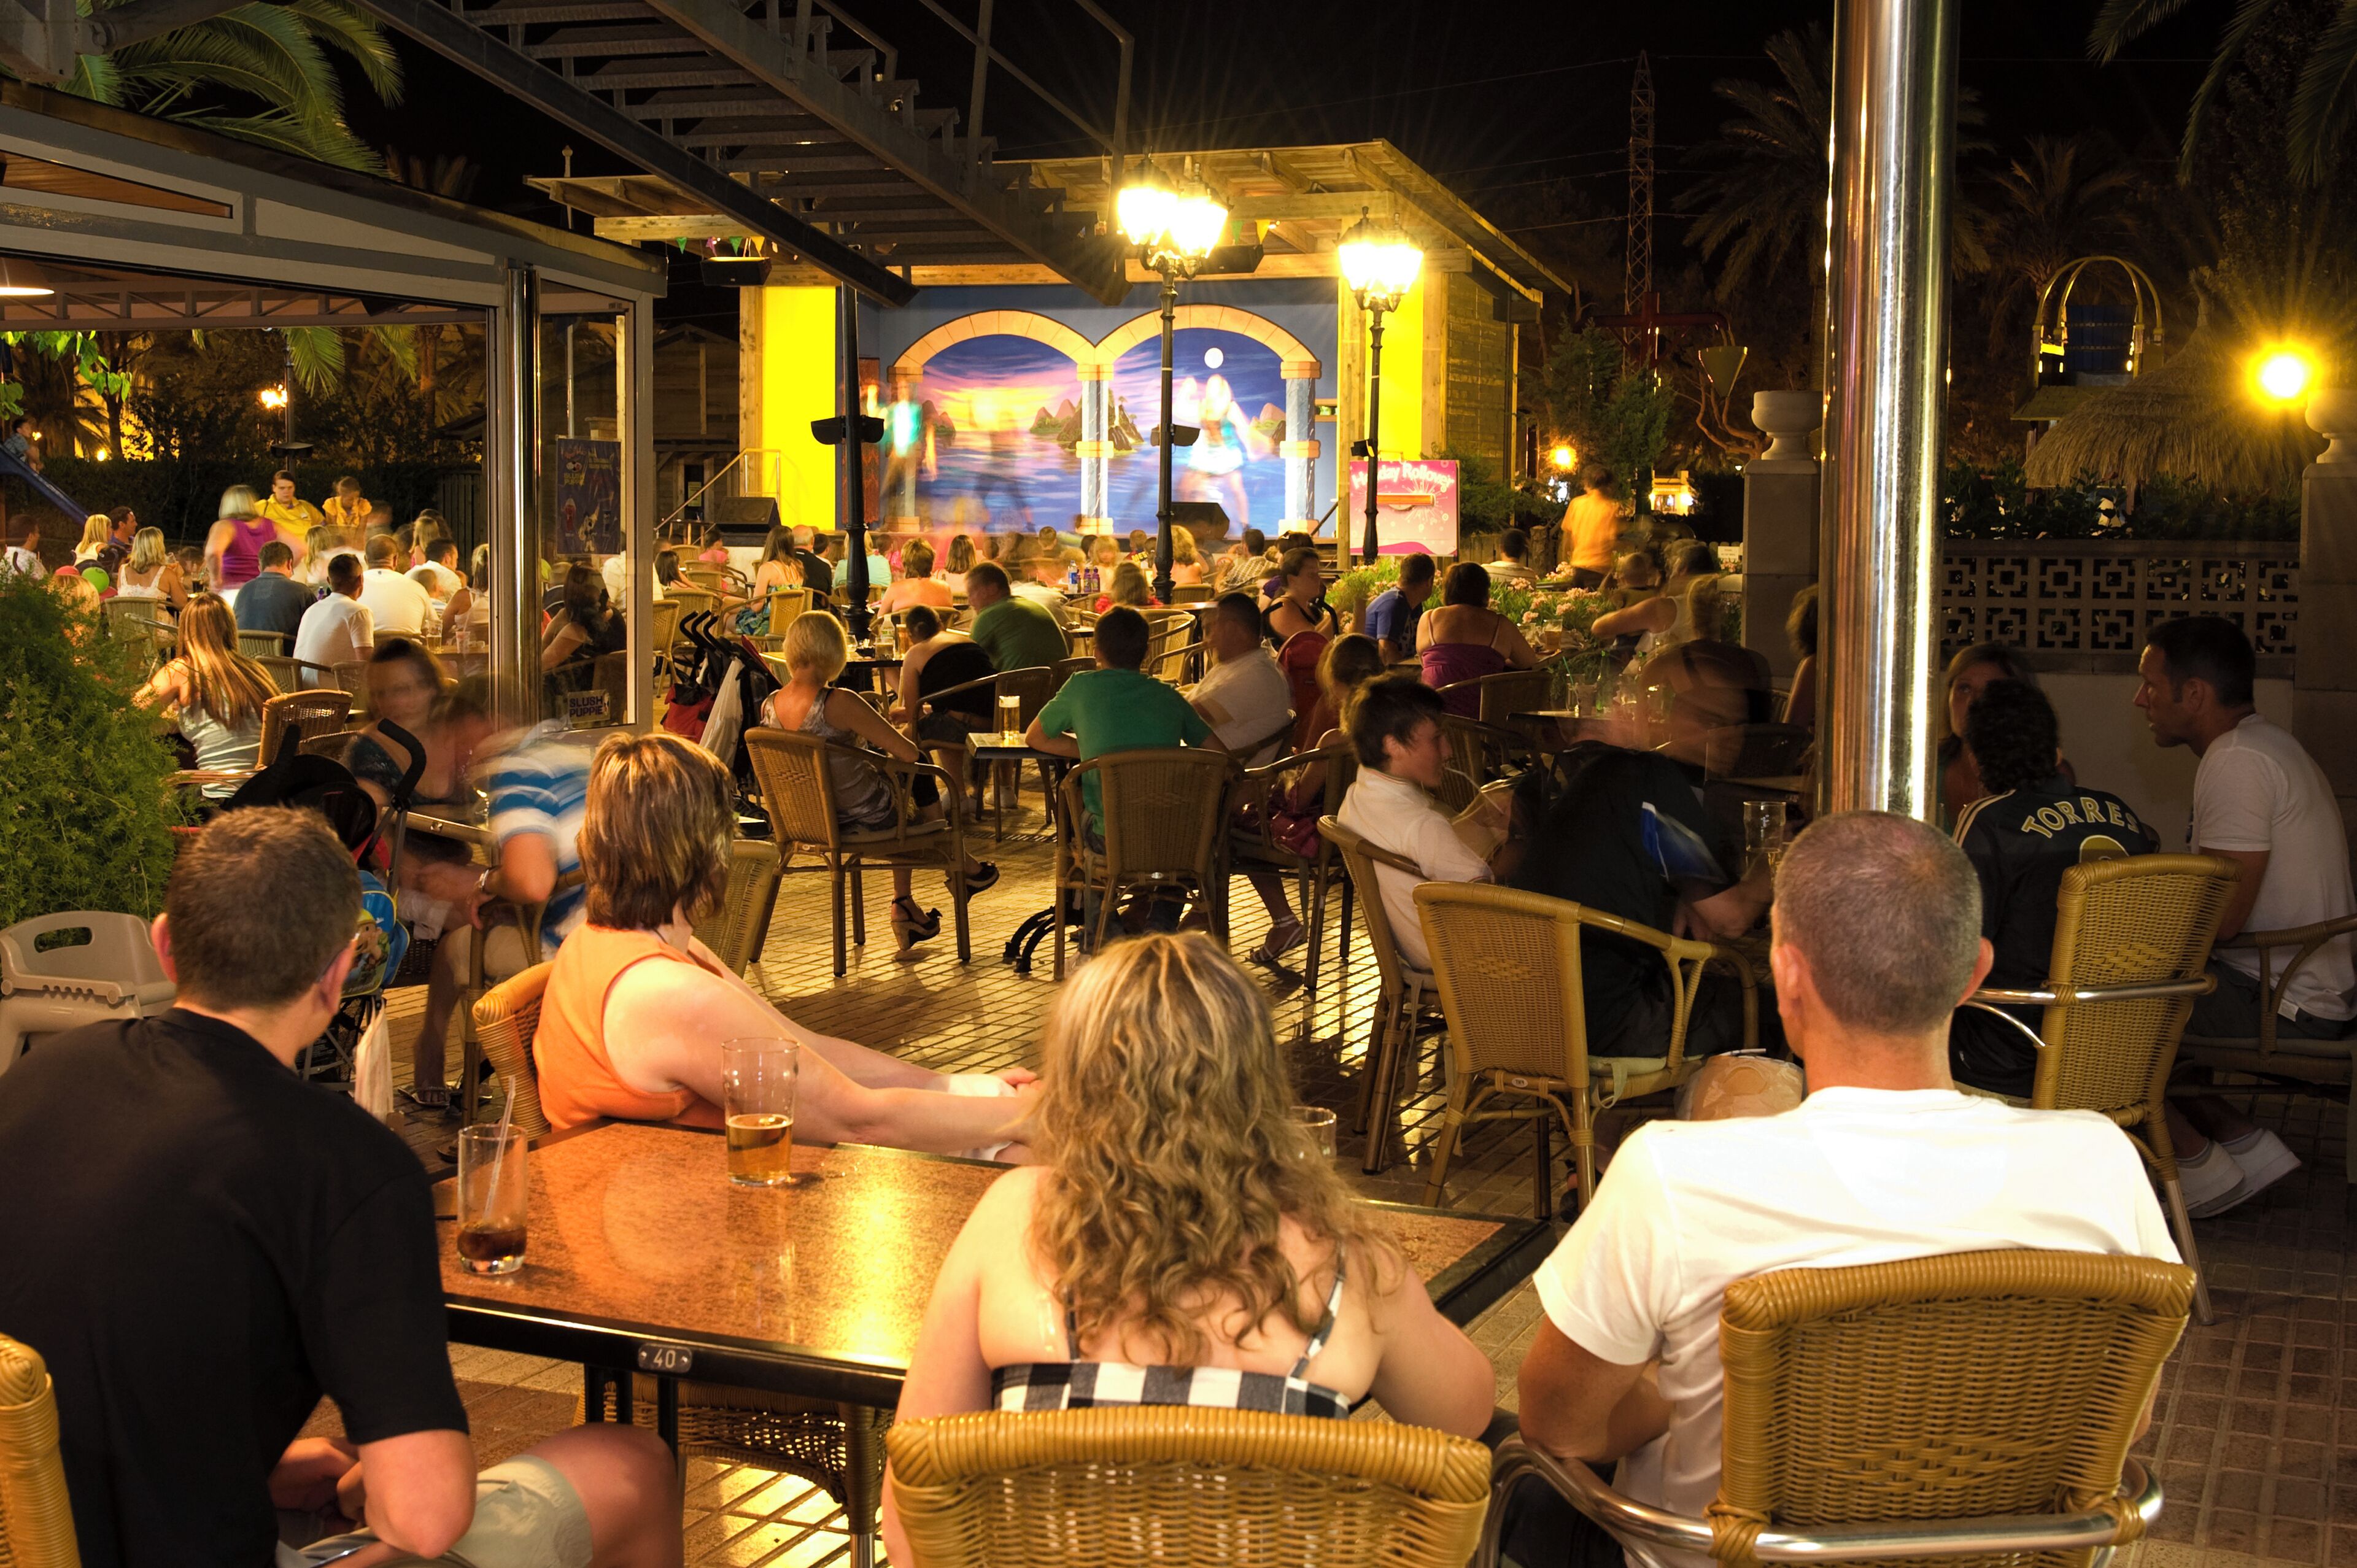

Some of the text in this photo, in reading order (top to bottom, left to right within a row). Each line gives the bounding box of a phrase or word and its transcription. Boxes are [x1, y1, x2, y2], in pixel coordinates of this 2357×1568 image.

[1403, 462, 1455, 488] Rollover
[570, 696, 603, 708] SLUSH
[2021, 797, 2139, 838] TORRES
[653, 1348, 676, 1369] 40
